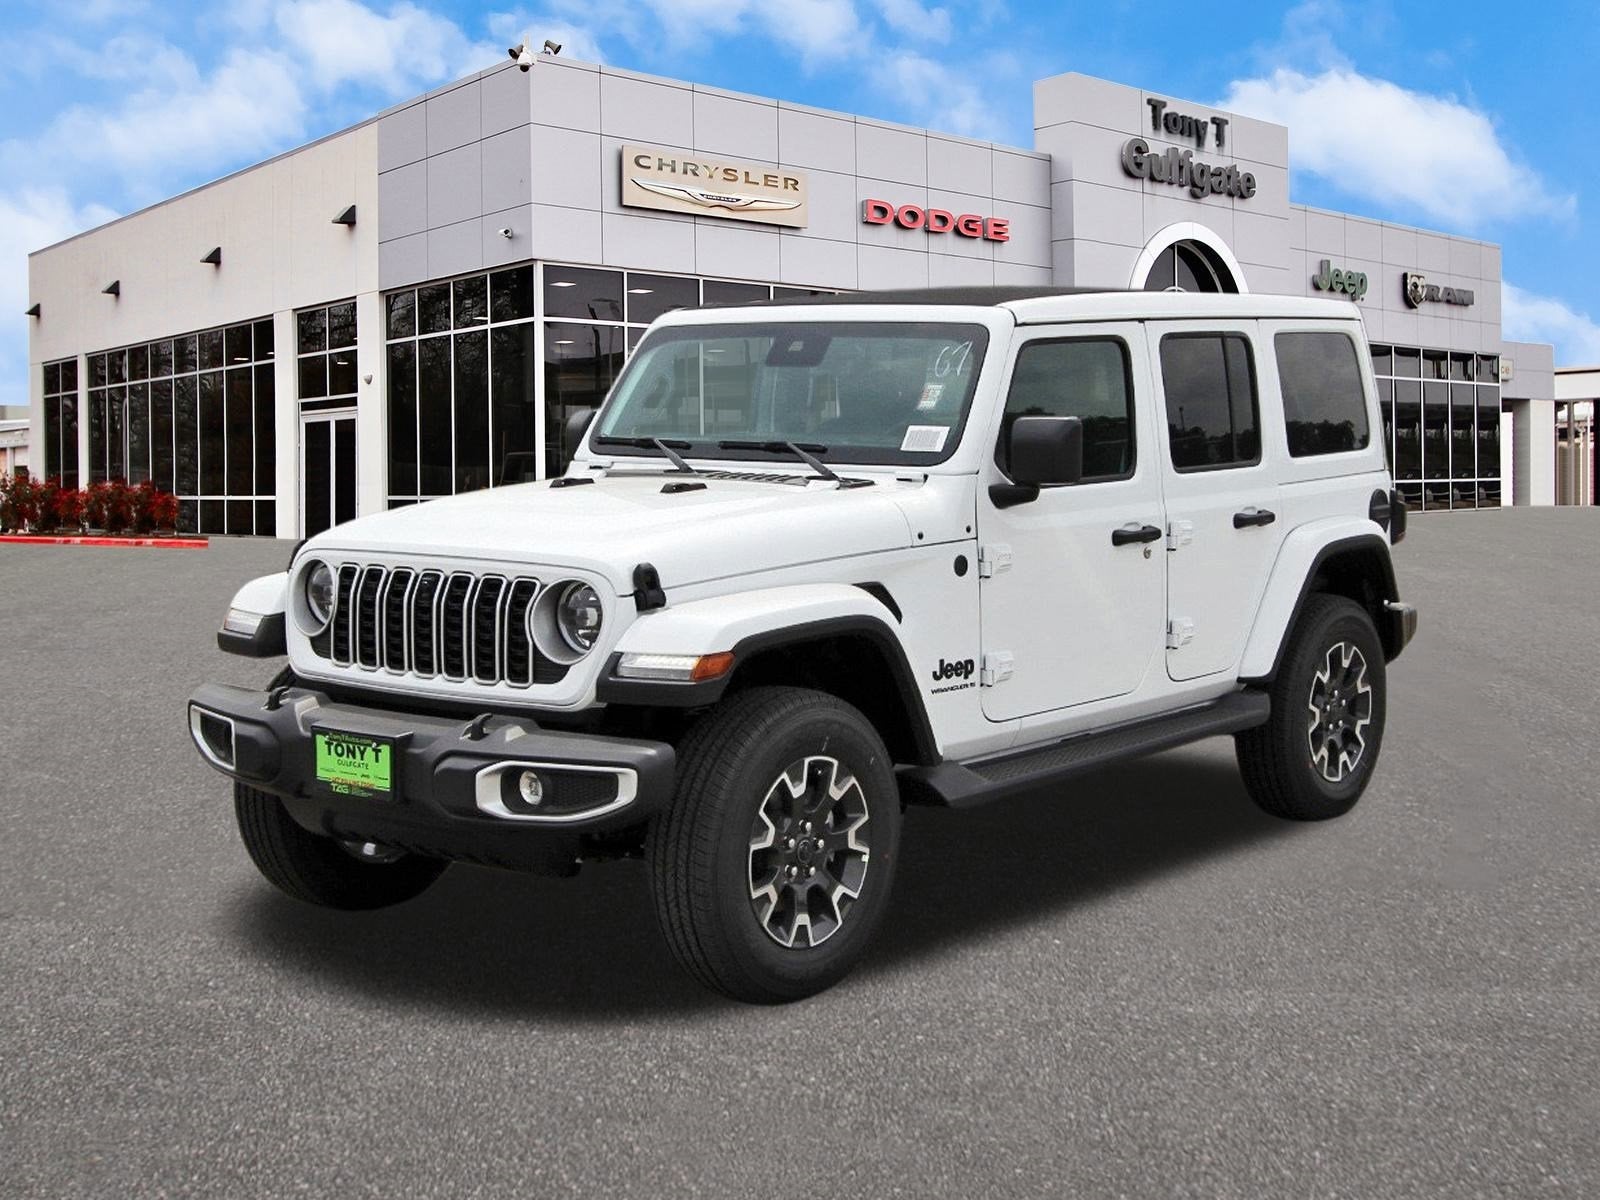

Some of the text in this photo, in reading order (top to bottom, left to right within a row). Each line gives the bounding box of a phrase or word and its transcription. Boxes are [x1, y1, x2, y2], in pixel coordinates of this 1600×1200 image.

[1146, 98, 1229, 148] Tony T
[633, 154, 800, 192] CHRYSLER
[1121, 137, 1257, 199] Gulfgate
[862, 198, 1010, 242] DODGE
[1312, 259, 1368, 300] Jeep
[1425, 283, 1475, 307] RAM
[932, 658, 975, 681] Jeep
[325, 741, 382, 763] TONY T
